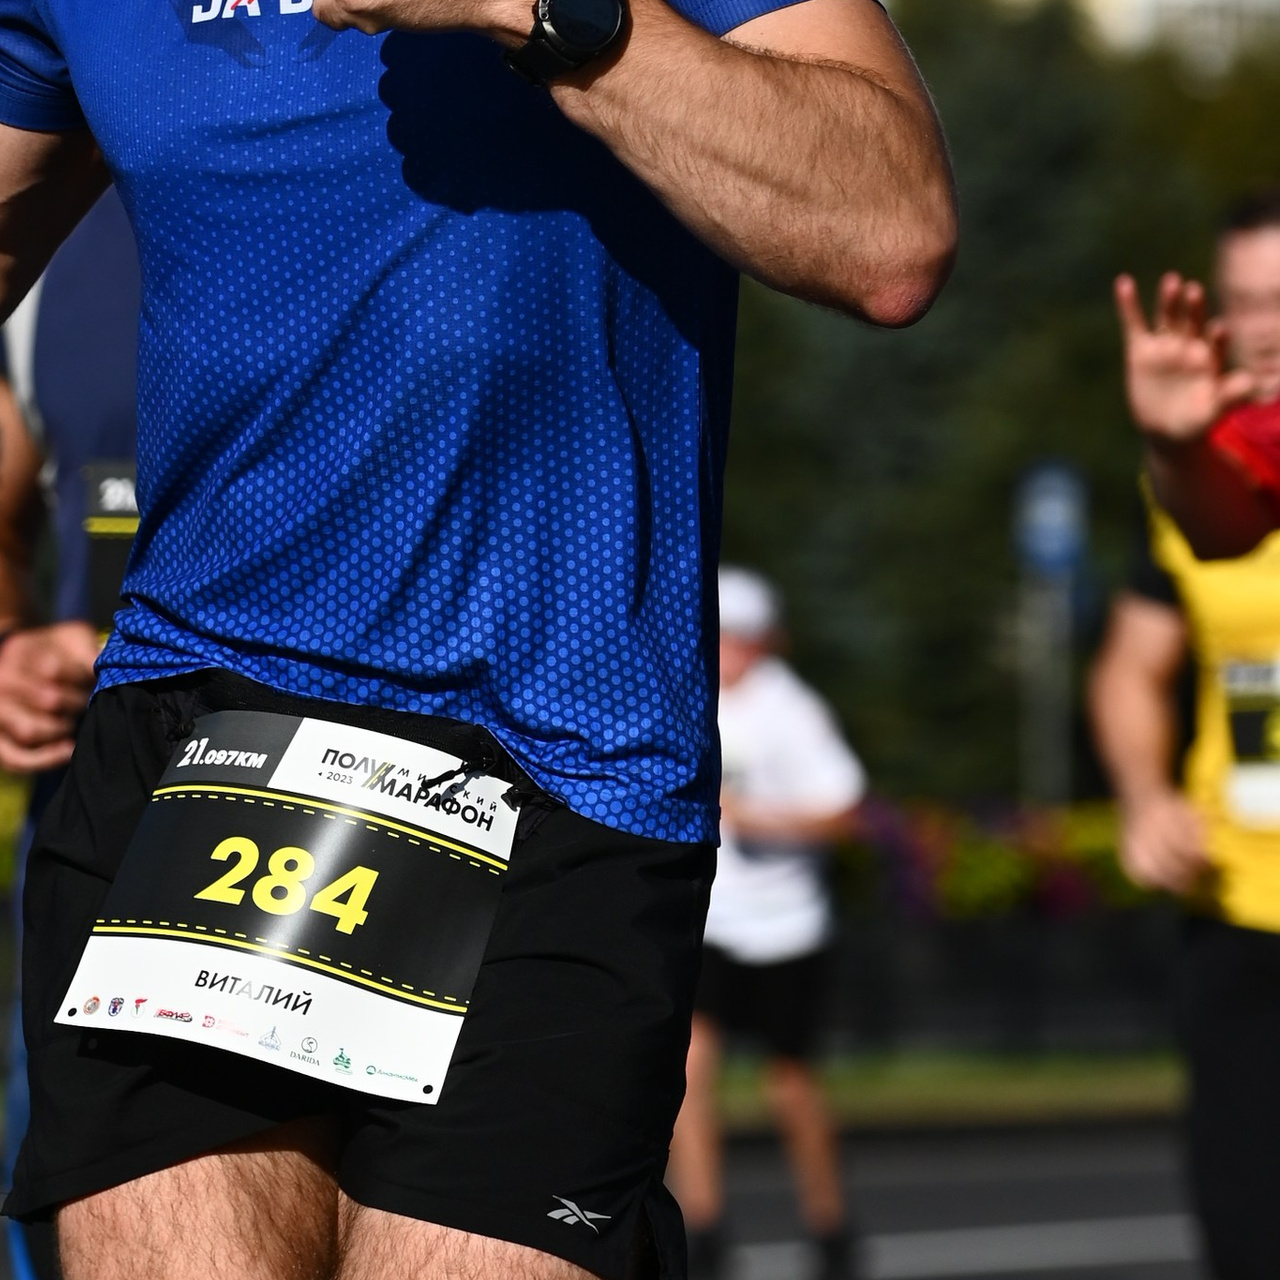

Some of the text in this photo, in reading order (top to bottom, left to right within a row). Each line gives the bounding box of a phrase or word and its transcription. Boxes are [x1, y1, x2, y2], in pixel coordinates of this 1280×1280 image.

[326, 771, 354, 785] 2023
[397, 757, 498, 813] МИСКИЙ
[193, 836, 380, 936] 284
[194, 970, 314, 1016] ВИТАЛИЙ
[289, 1051, 321, 1067] DARIDA
